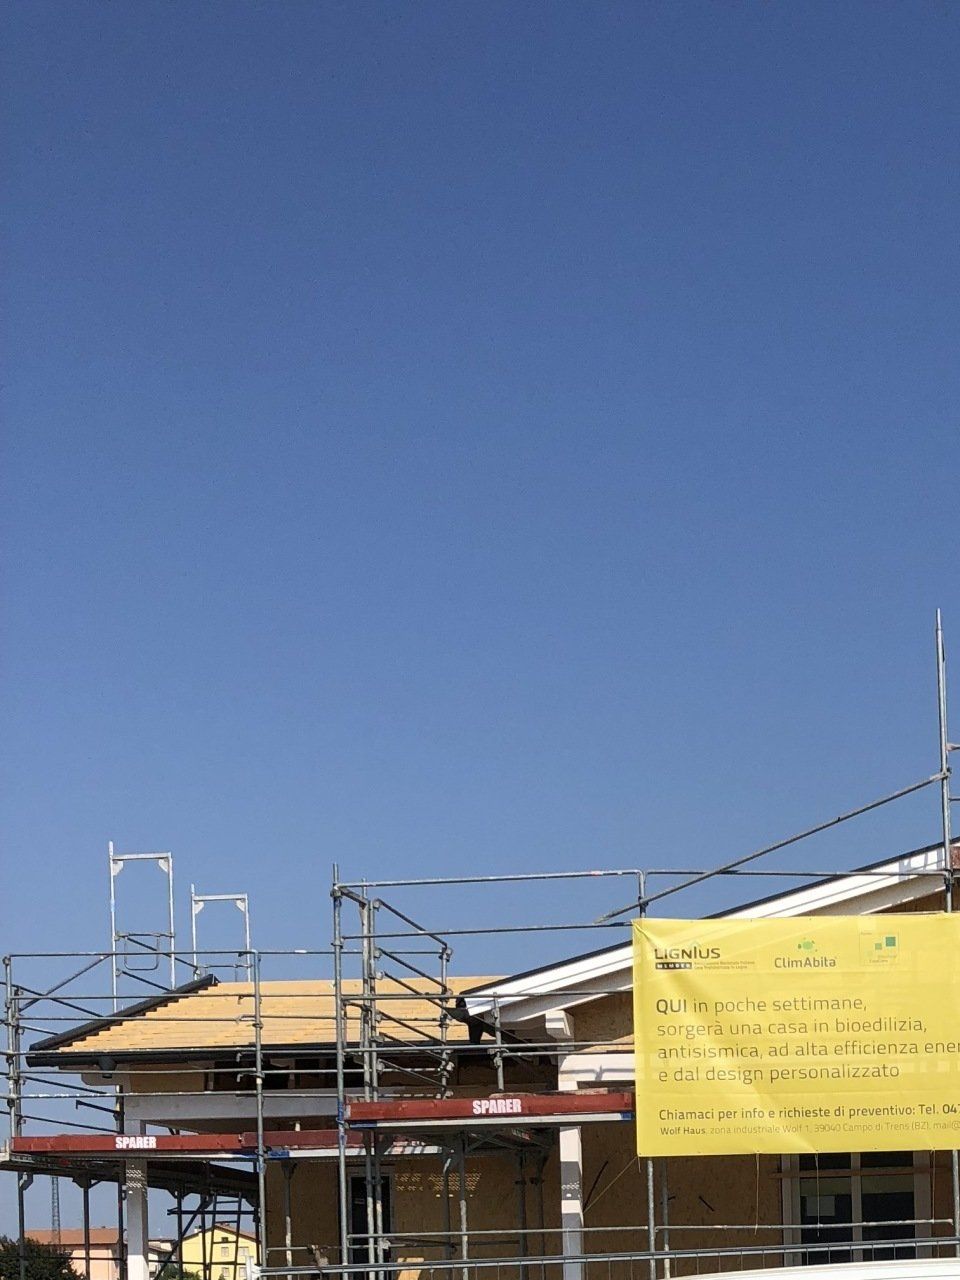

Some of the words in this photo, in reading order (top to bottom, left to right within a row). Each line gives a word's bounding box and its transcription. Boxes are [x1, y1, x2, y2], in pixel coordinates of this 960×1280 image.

[656, 998, 687, 1014] QUI
[693, 998, 708, 1013] in
[714, 997, 767, 1016] poche
[772, 996, 867, 1011] settimane,
[657, 1020, 724, 1040] sorgerà
[729, 1022, 762, 1036] una
[768, 1020, 808, 1034] casa
[814, 1018, 829, 1033] in
[835, 1016, 927, 1033] bioedilizia,
[658, 1043, 763, 1060] antisismica,
[768, 1042, 789, 1057] ad
[795, 1041, 829, 1056] alta
[834, 1040, 918, 1056] efficienza
[658, 1070, 668, 1082] e
[673, 1067, 699, 1081] dal
[705, 1066, 763, 1085] design
[770, 1063, 900, 1083] personalizzato
[471, 1099, 522, 1114] SPARER
[659, 1108, 714, 1121] Chiamaci
[718, 1110, 737, 1122] per
[741, 1107, 765, 1119] info
[768, 1110, 776, 1118] e
[779, 1106, 831, 1118] richieste
[833, 1106, 845, 1117] di
[849, 1105, 916, 1119] preventivo:
[918, 1104, 939, 1116] Tel.
[660, 1127, 681, 1136] Wolf
[710, 1126, 732, 1135] zona
[733, 1124, 781, 1135] industriale
[783, 1123, 803, 1134] Wolf
[814, 1123, 842, 1133] 39040
[843, 1123, 874, 1133] Campo
[875, 1122, 883, 1131] di
[115, 1136, 157, 1149] SPARER
